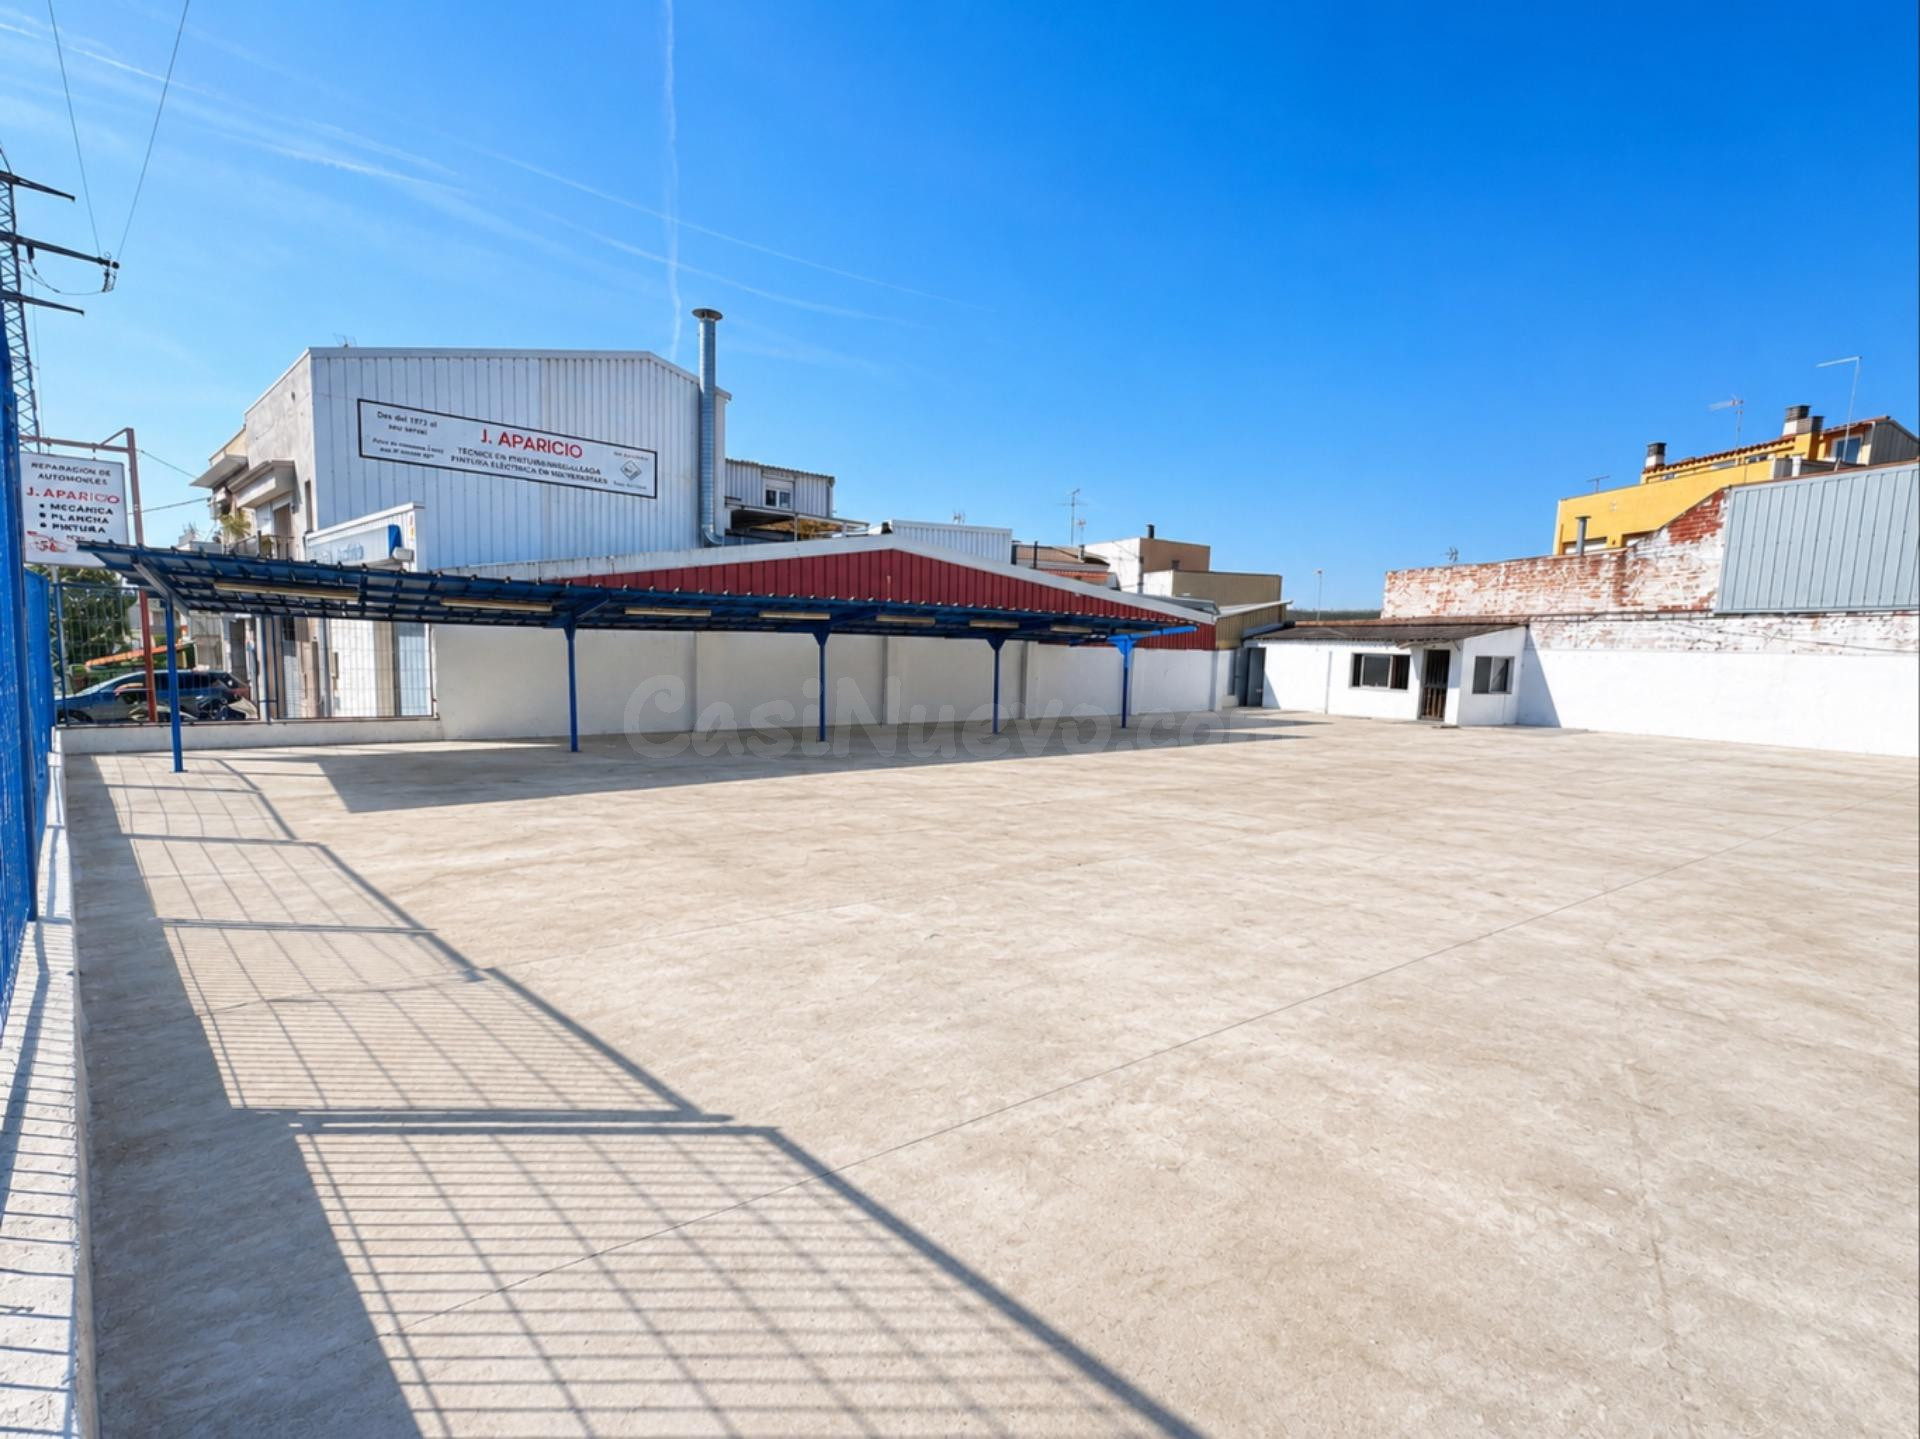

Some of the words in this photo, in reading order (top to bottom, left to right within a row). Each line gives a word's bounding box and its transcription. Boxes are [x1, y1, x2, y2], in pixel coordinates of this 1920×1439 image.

[480, 428, 492, 444] J.
[498, 431, 583, 459] APARICIO
[98, 469, 111, 477] DE
[26, 486, 40, 497] J.
[43, 488, 120, 504] APARICIO
[51, 513, 110, 524] PLANCHA
